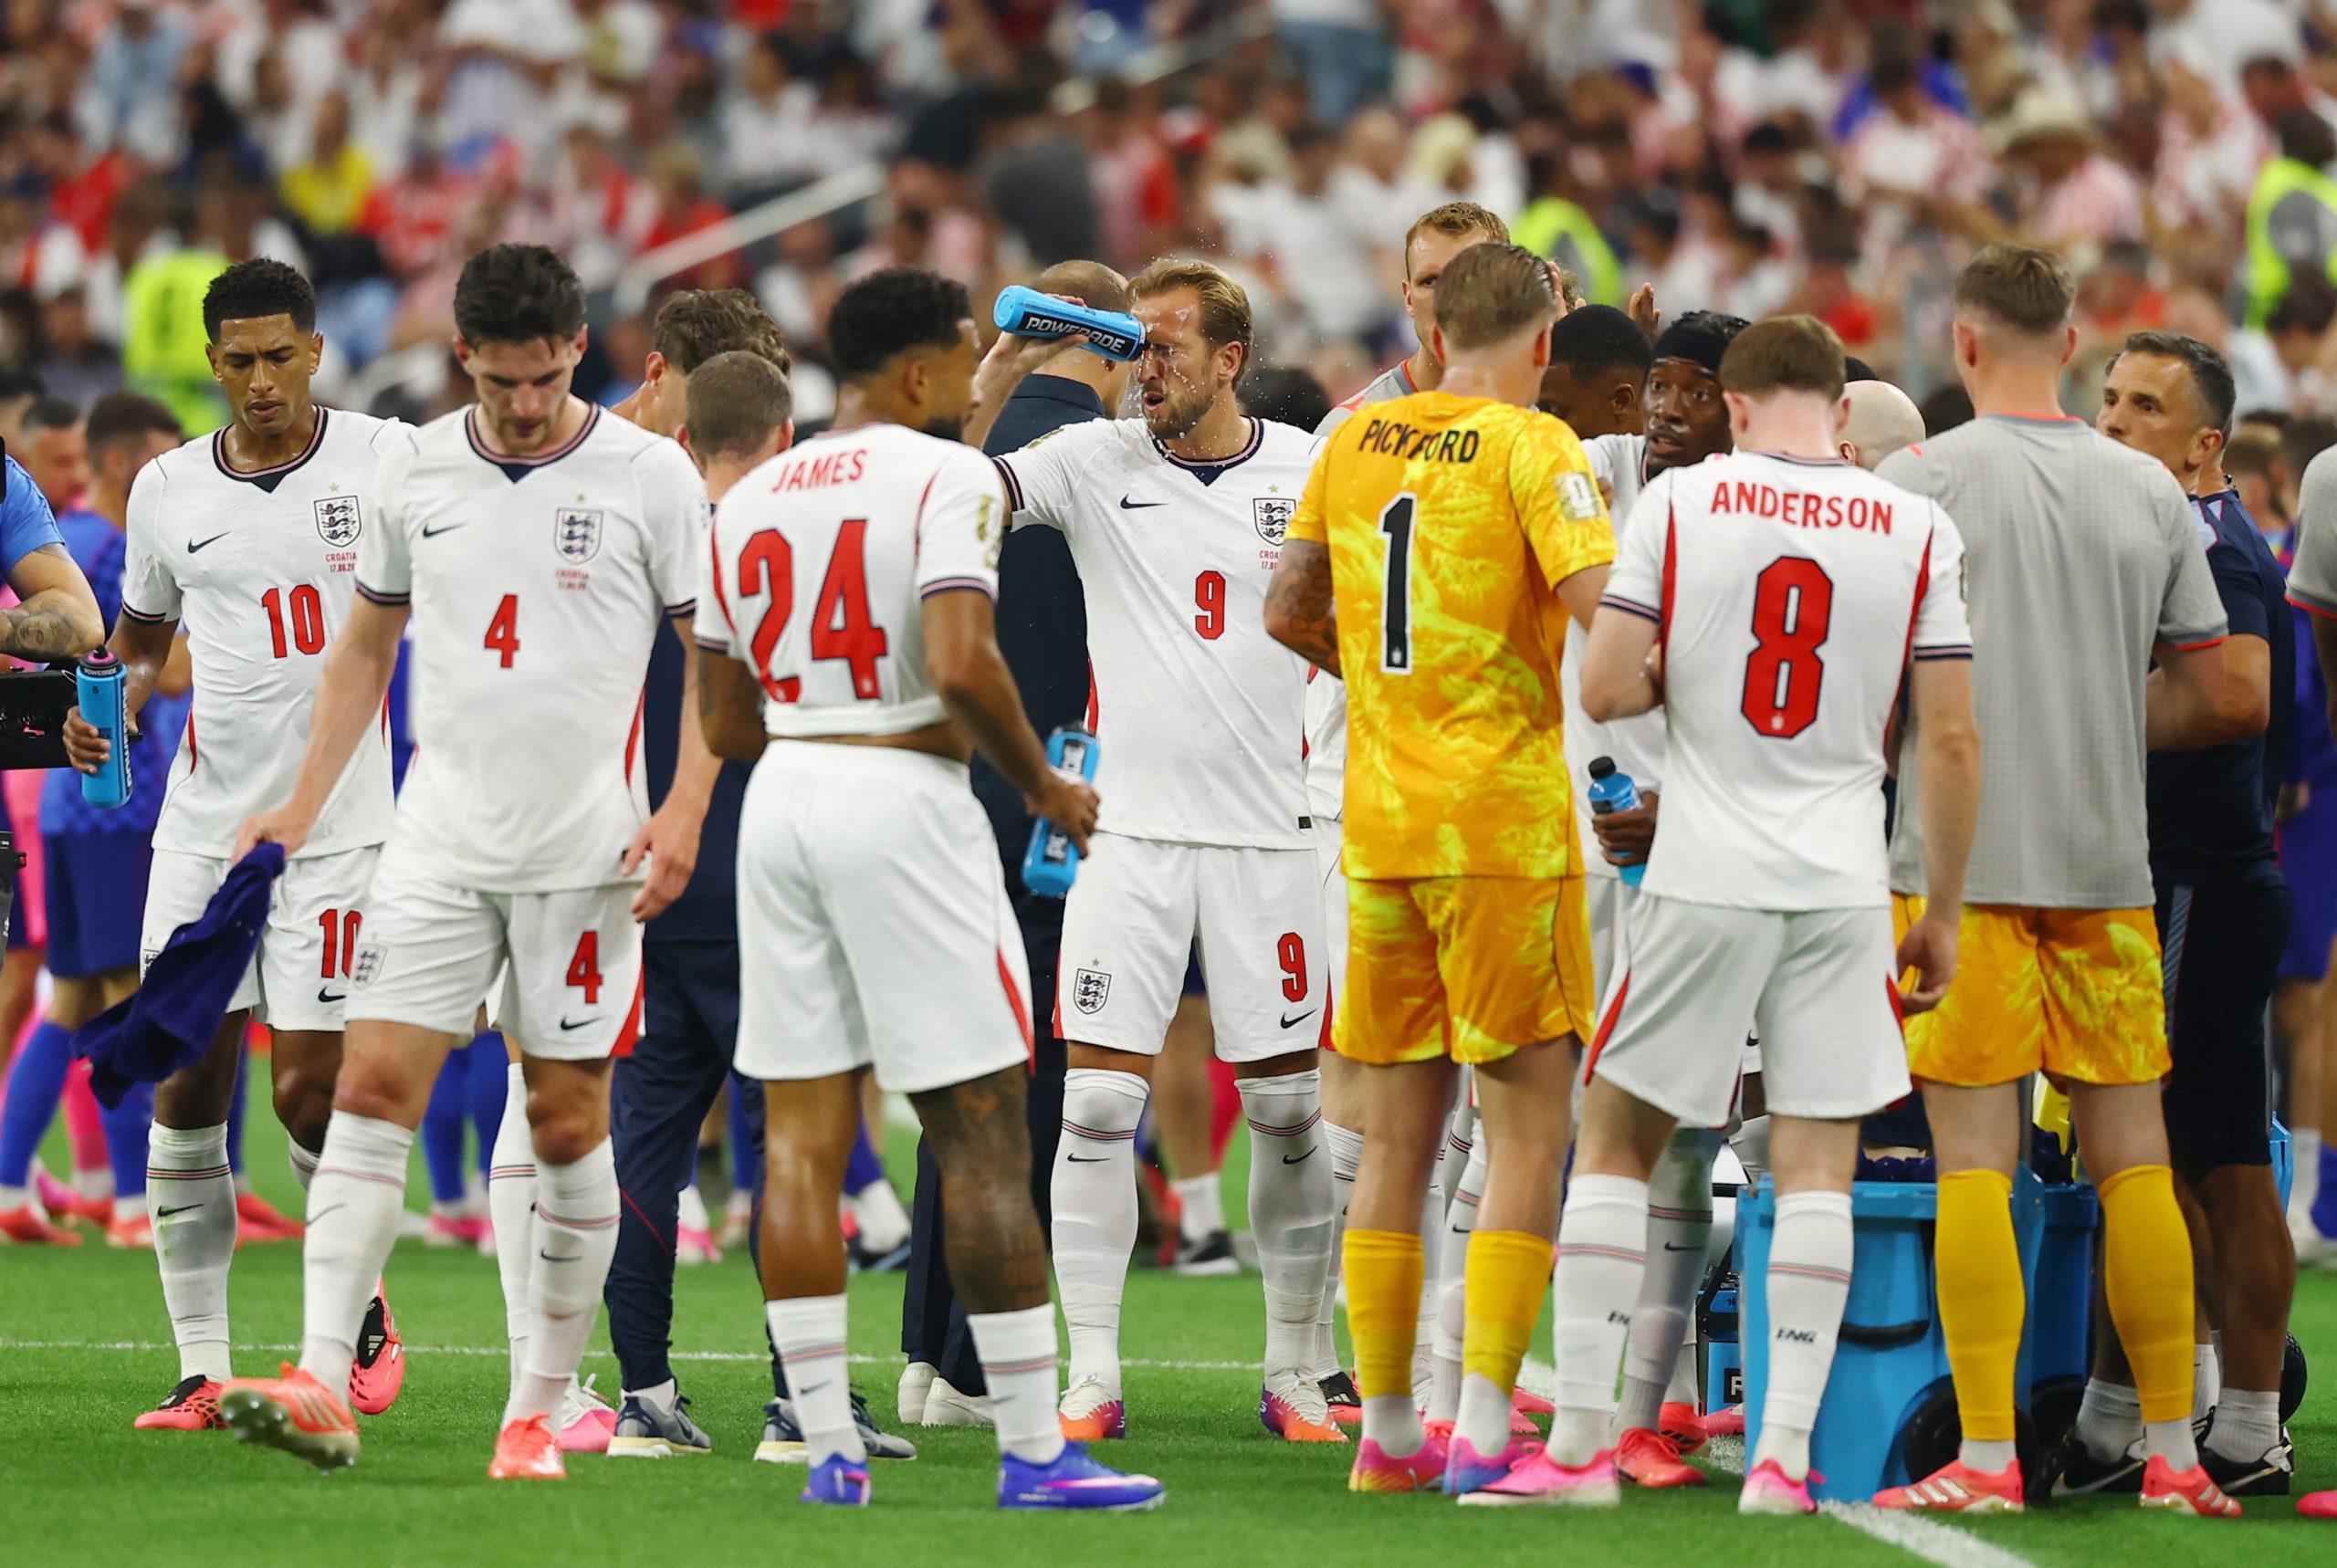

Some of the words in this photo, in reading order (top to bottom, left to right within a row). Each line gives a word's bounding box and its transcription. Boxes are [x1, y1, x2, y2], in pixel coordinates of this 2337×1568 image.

[771, 449, 867, 494] JAMES
[1711, 481, 1892, 536] ANDERSON
[325, 551, 357, 563] CROATIA
[1378, 491, 1418, 675] 1
[261, 583, 326, 660] 10
[483, 593, 520, 670] 4
[736, 518, 888, 704] 24
[1194, 569, 1227, 642] 9
[1740, 554, 1834, 741] 8
[319, 908, 362, 979] 10
[565, 929, 604, 1006] 4
[1276, 931, 1309, 1004] 9
[1777, 1326, 1818, 1344] ENG
